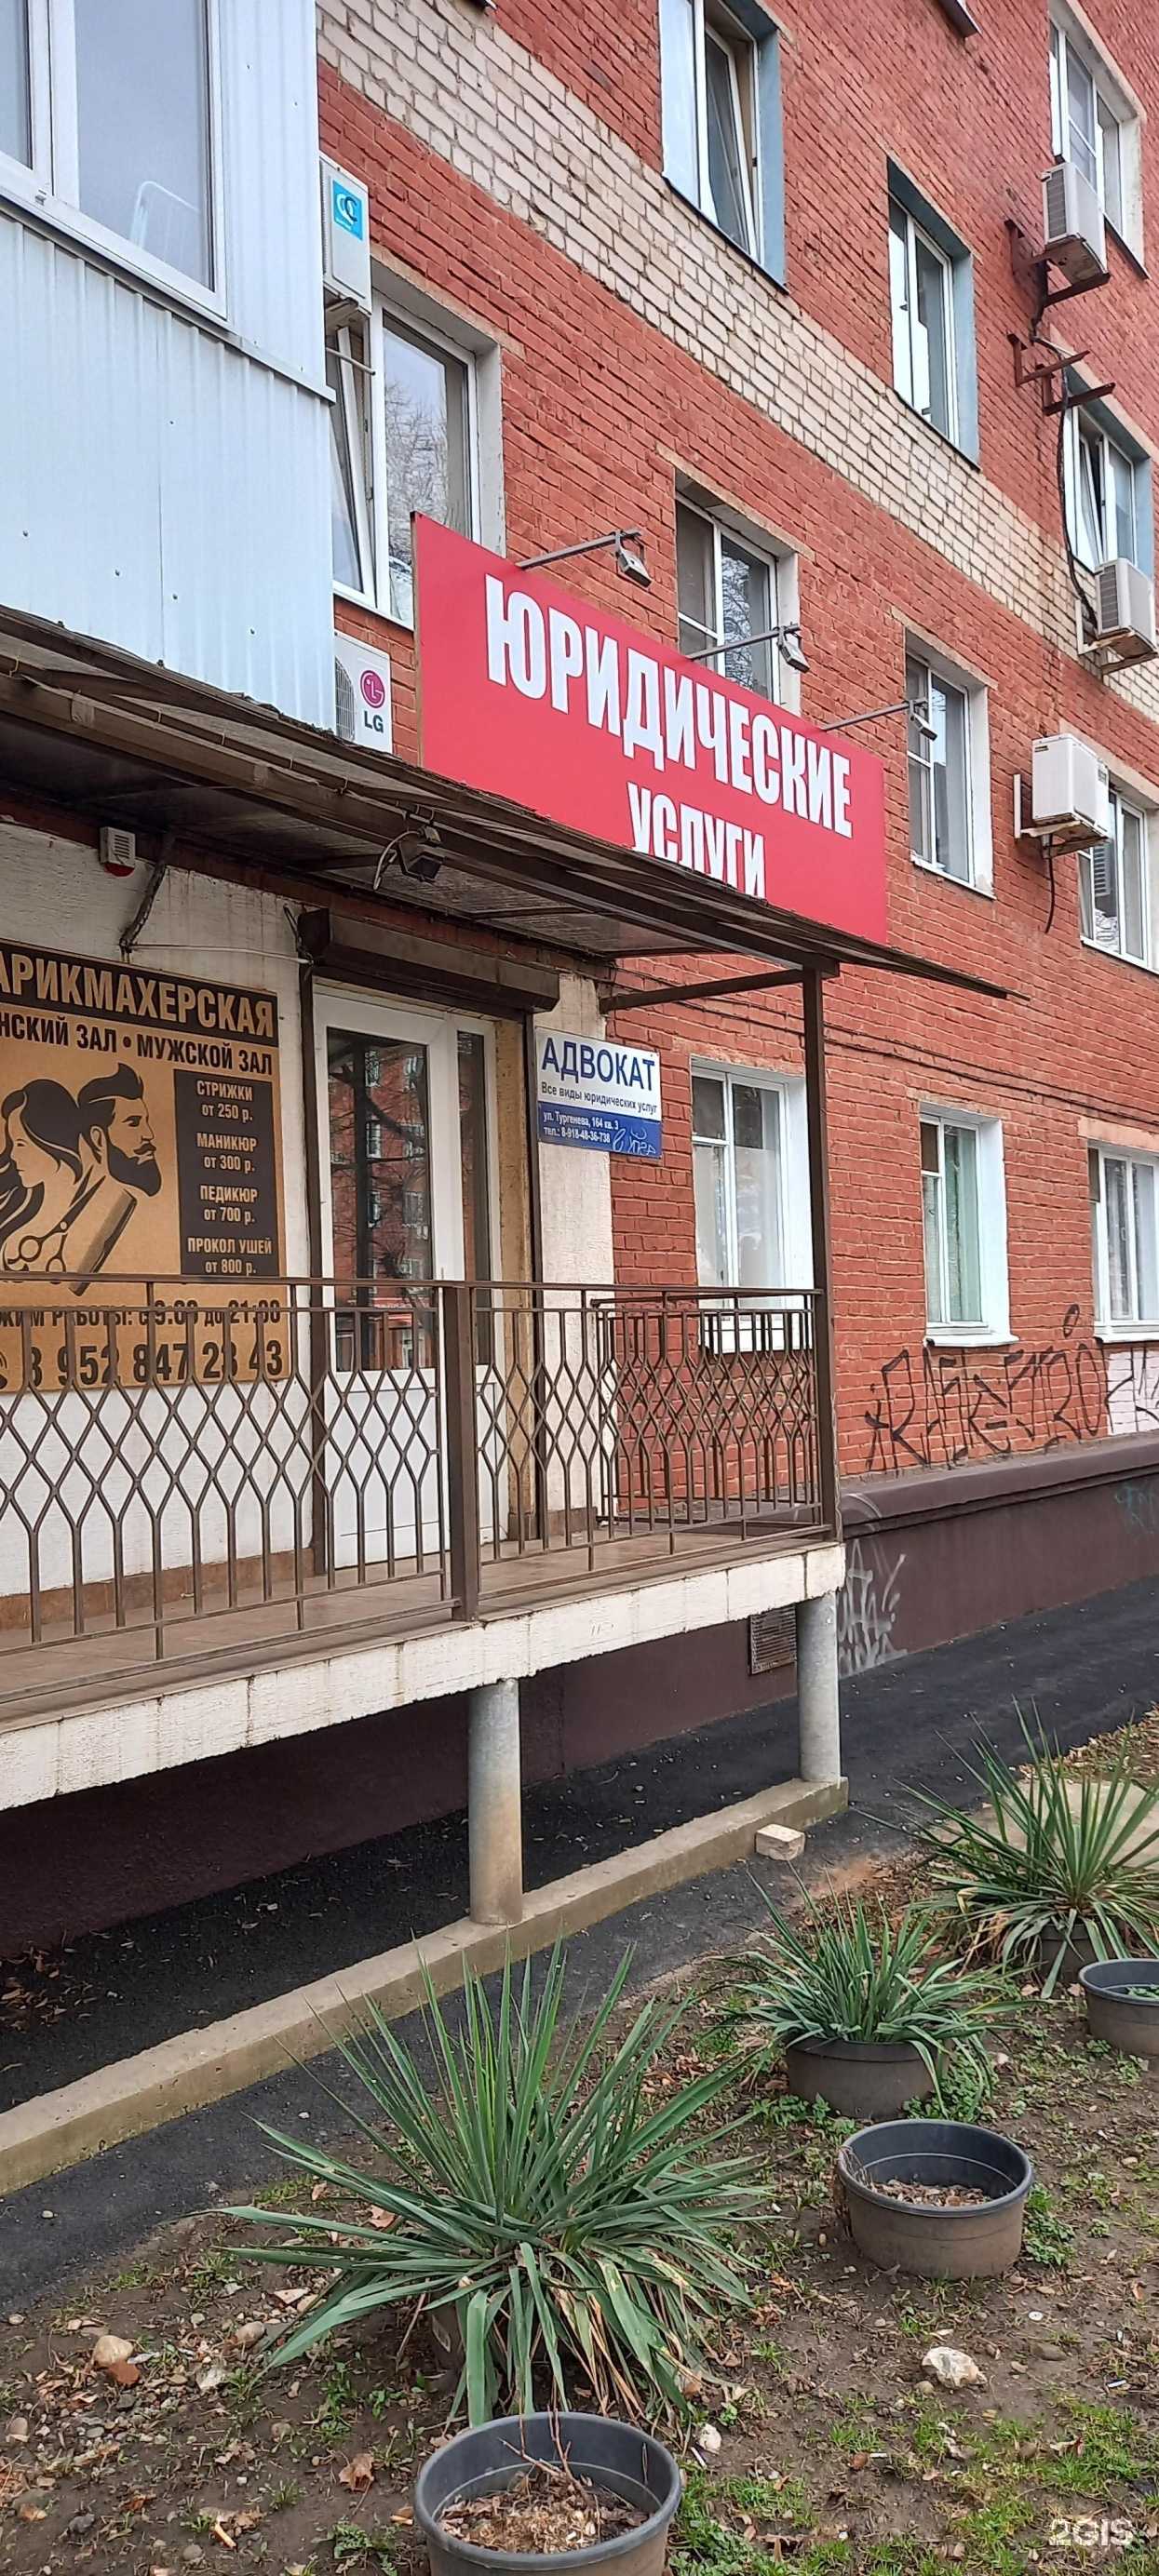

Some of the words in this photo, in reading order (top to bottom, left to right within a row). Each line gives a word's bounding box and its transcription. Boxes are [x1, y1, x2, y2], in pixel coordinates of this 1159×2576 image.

[484, 572, 855, 839] ЮРИДИЧЕСКИЕ
[364, 709, 384, 733] LG
[627, 781, 767, 901] УСЛУГИ
[75, 1023, 117, 1053] ЗАЛ
[137, 1032, 234, 1070] МУЖСКОЙ
[238, 1048, 273, 1076] ЗАЛ
[542, 1037, 655, 1092] АДВОКАТ
[196, 1080, 254, 1102] СТРИЖКИ
[541, 1081, 558, 1095] Все
[559, 1087, 583, 1101] виды
[584, 1092, 637, 1110] юридических
[638, 1101, 657, 1115] услуг
[201, 1104, 215, 1117] от
[217, 1103, 239, 1120] 250
[241, 1108, 253, 1123] р.
[543, 1111, 555, 1123] ул.
[555, 1110, 591, 1129] Тургенева,
[614, 1120, 620, 1132] 3
[196, 1132, 258, 1153] МАНИКЮР
[203, 1156, 217, 1169] от
[219, 1154, 241, 1171] 300
[244, 1160, 256, 1174] р.
[199, 1184, 258, 1204] ПЕДИКЮР
[203, 1208, 217, 1221] от
[219, 1206, 241, 1222] 700
[244, 1211, 256, 1226] р.
[187, 1237, 236, 1254] ПРОКОЛ
[238, 1237, 273, 1255] УШЕЙ
[205, 1260, 219, 1274] от
[221, 1258, 243, 1274] 800
[245, 1262, 257, 1277] р.
